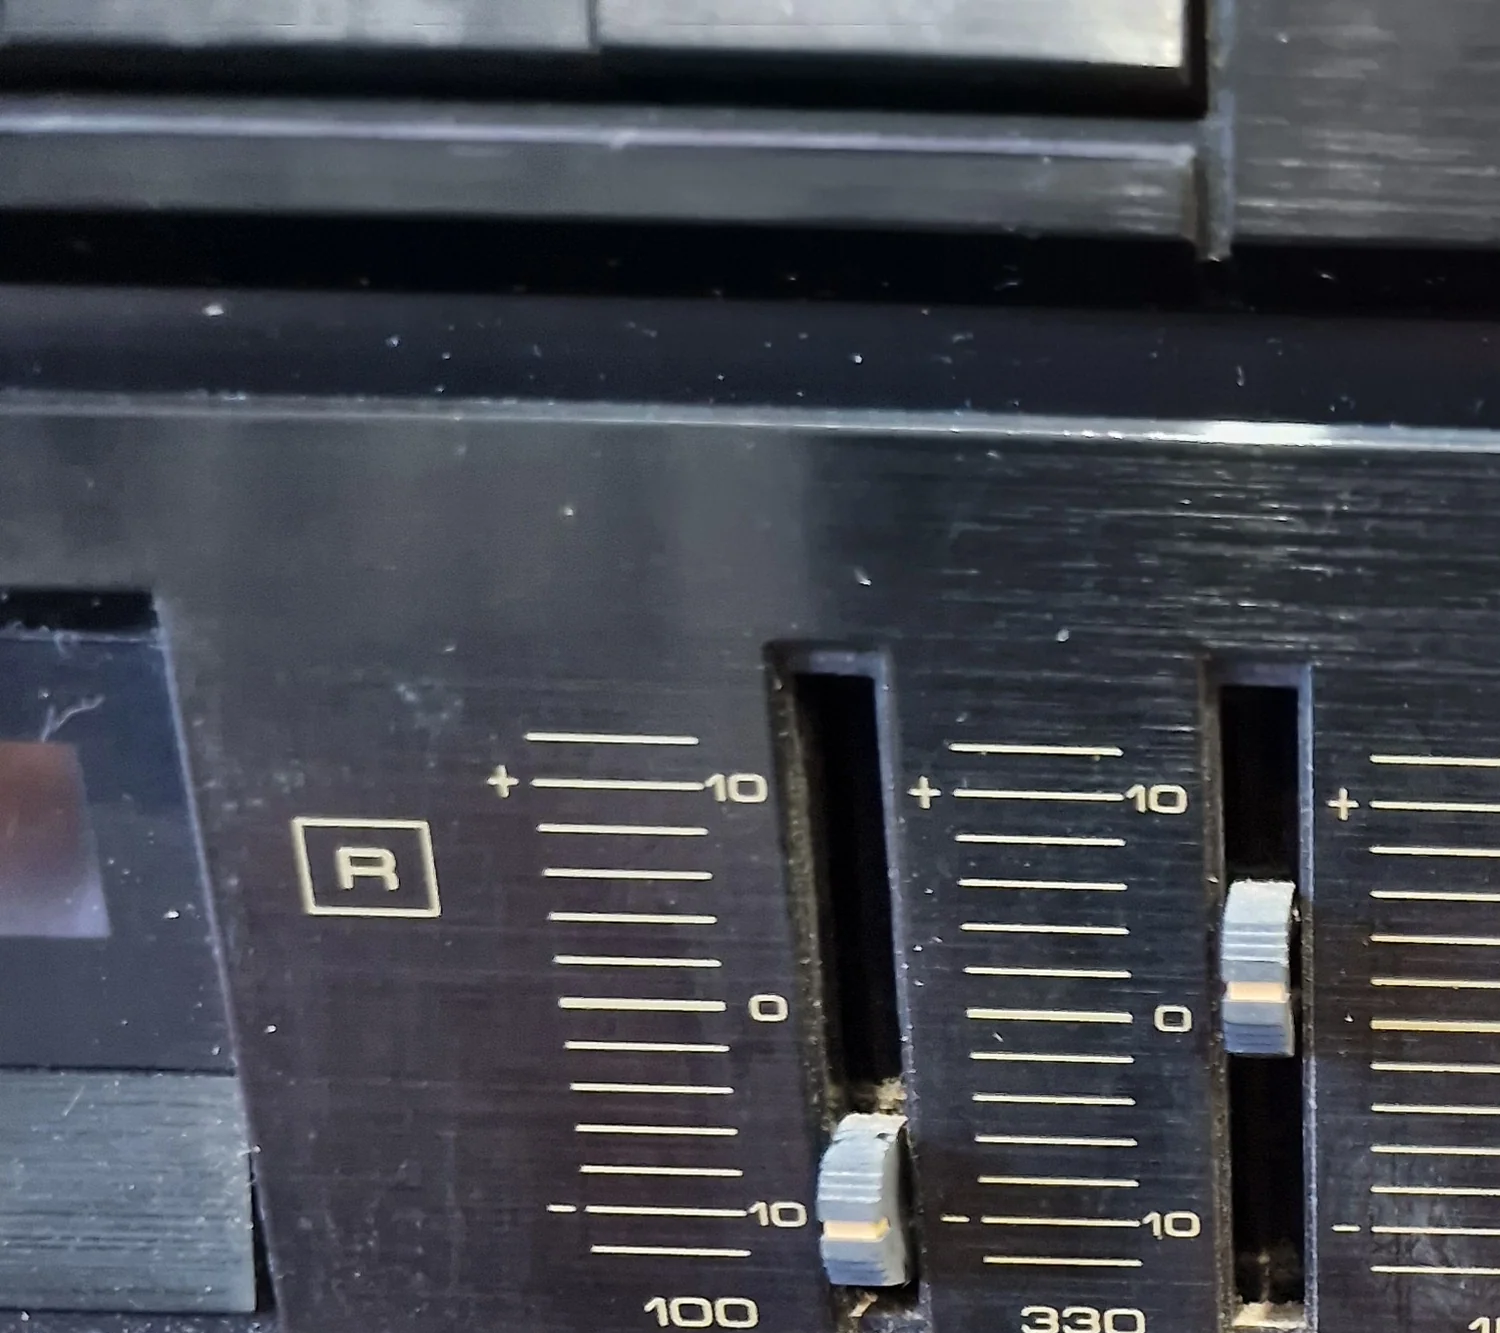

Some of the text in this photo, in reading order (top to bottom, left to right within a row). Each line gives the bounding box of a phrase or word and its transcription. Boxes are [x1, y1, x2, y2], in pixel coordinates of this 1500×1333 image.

[700, 773, 768, 803] 10
[1125, 784, 1188, 814] 10
[335, 846, 399, 891] R
[748, 994, 788, 1022] 0
[1154, 1005, 1192, 1033] 0
[747, 1201, 807, 1228] 10
[1142, 1211, 1201, 1240] 10
[644, 1296, 758, 1329] 100
